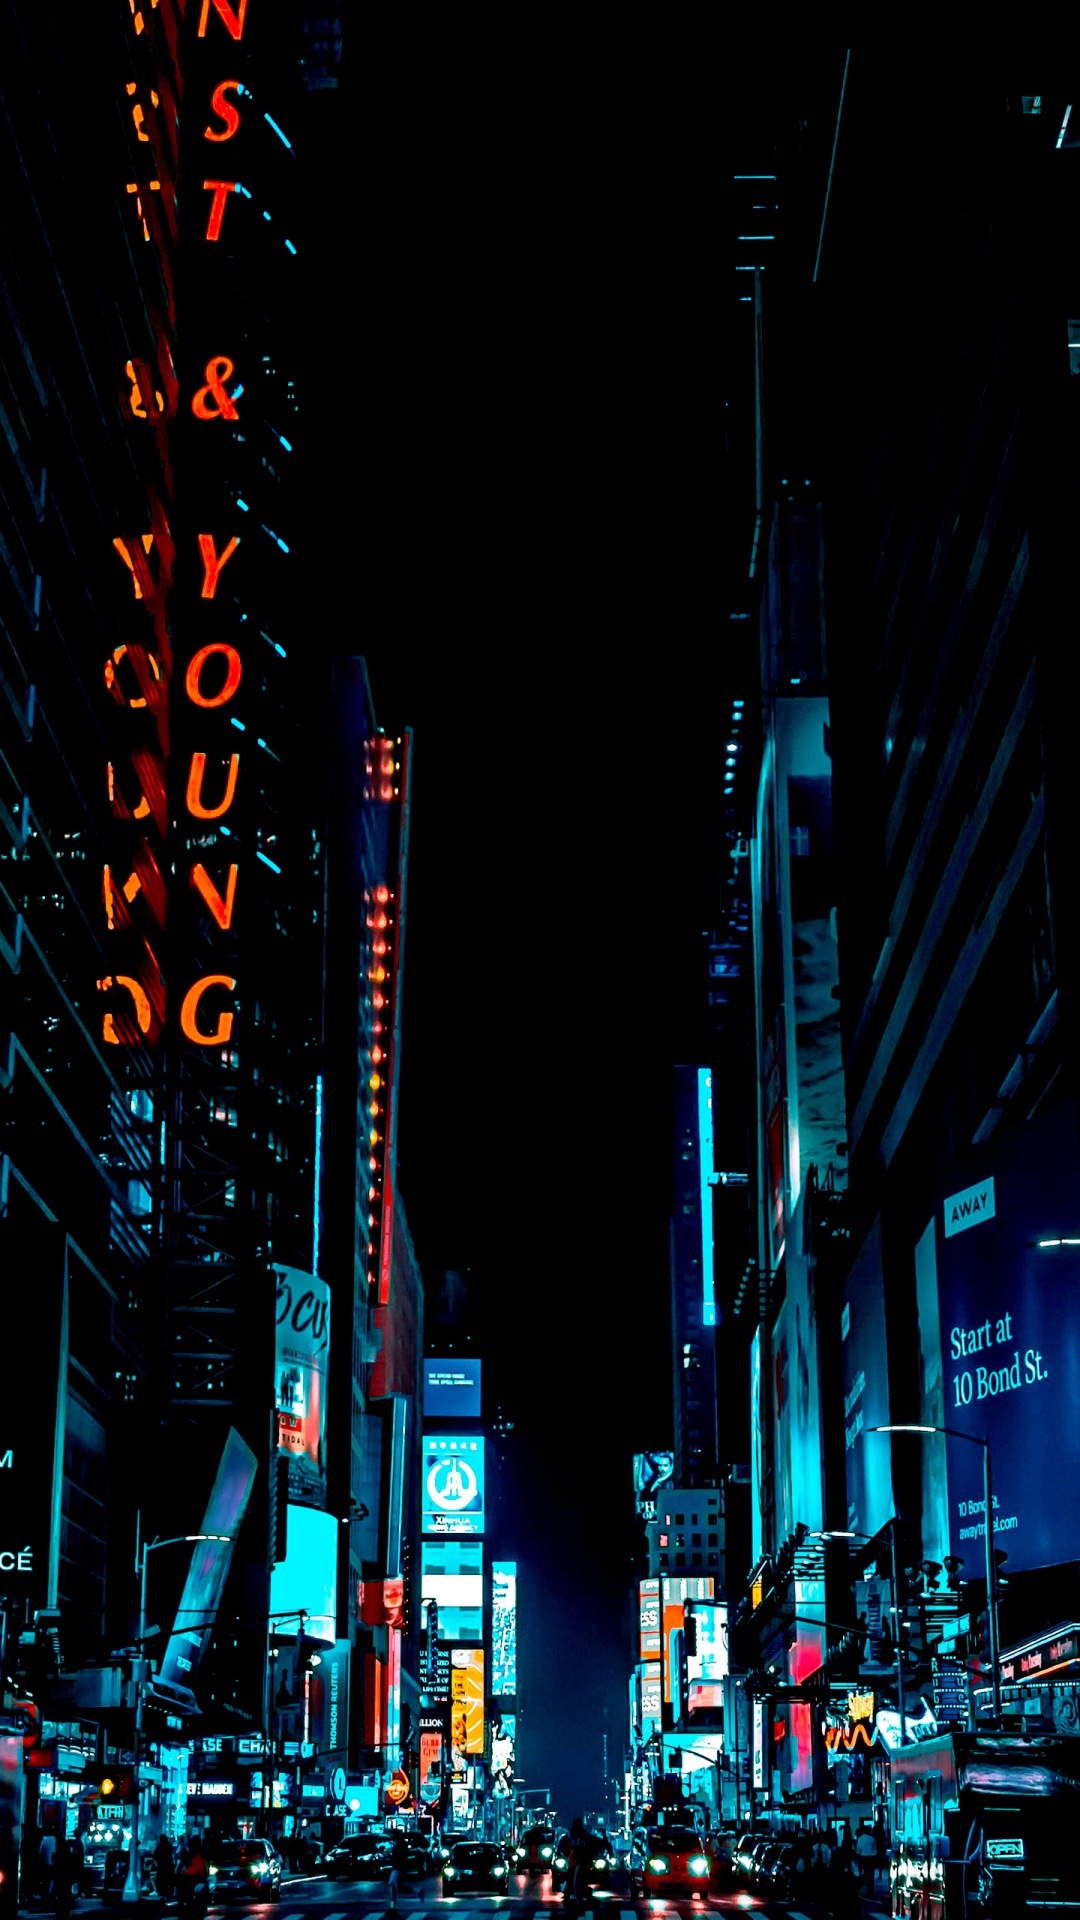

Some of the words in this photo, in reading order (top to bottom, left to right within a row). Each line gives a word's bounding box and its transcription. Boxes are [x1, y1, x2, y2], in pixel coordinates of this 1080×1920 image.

[191, 356, 243, 420] &
[180, 534, 242, 1046] YOUNG
[951, 1193, 989, 1223] AWAY
[951, 1318, 992, 1360] Start
[995, 1312, 1012, 1348] at
[953, 1373, 974, 1408] 10
[975, 1354, 1021, 1401] Bond
[1025, 1348, 1048, 1386] St.
[331, 1662, 339, 1702] REUTERS
[330, 1704, 338, 1750] THOMSON
[325, 1804, 348, 1817] CASE
